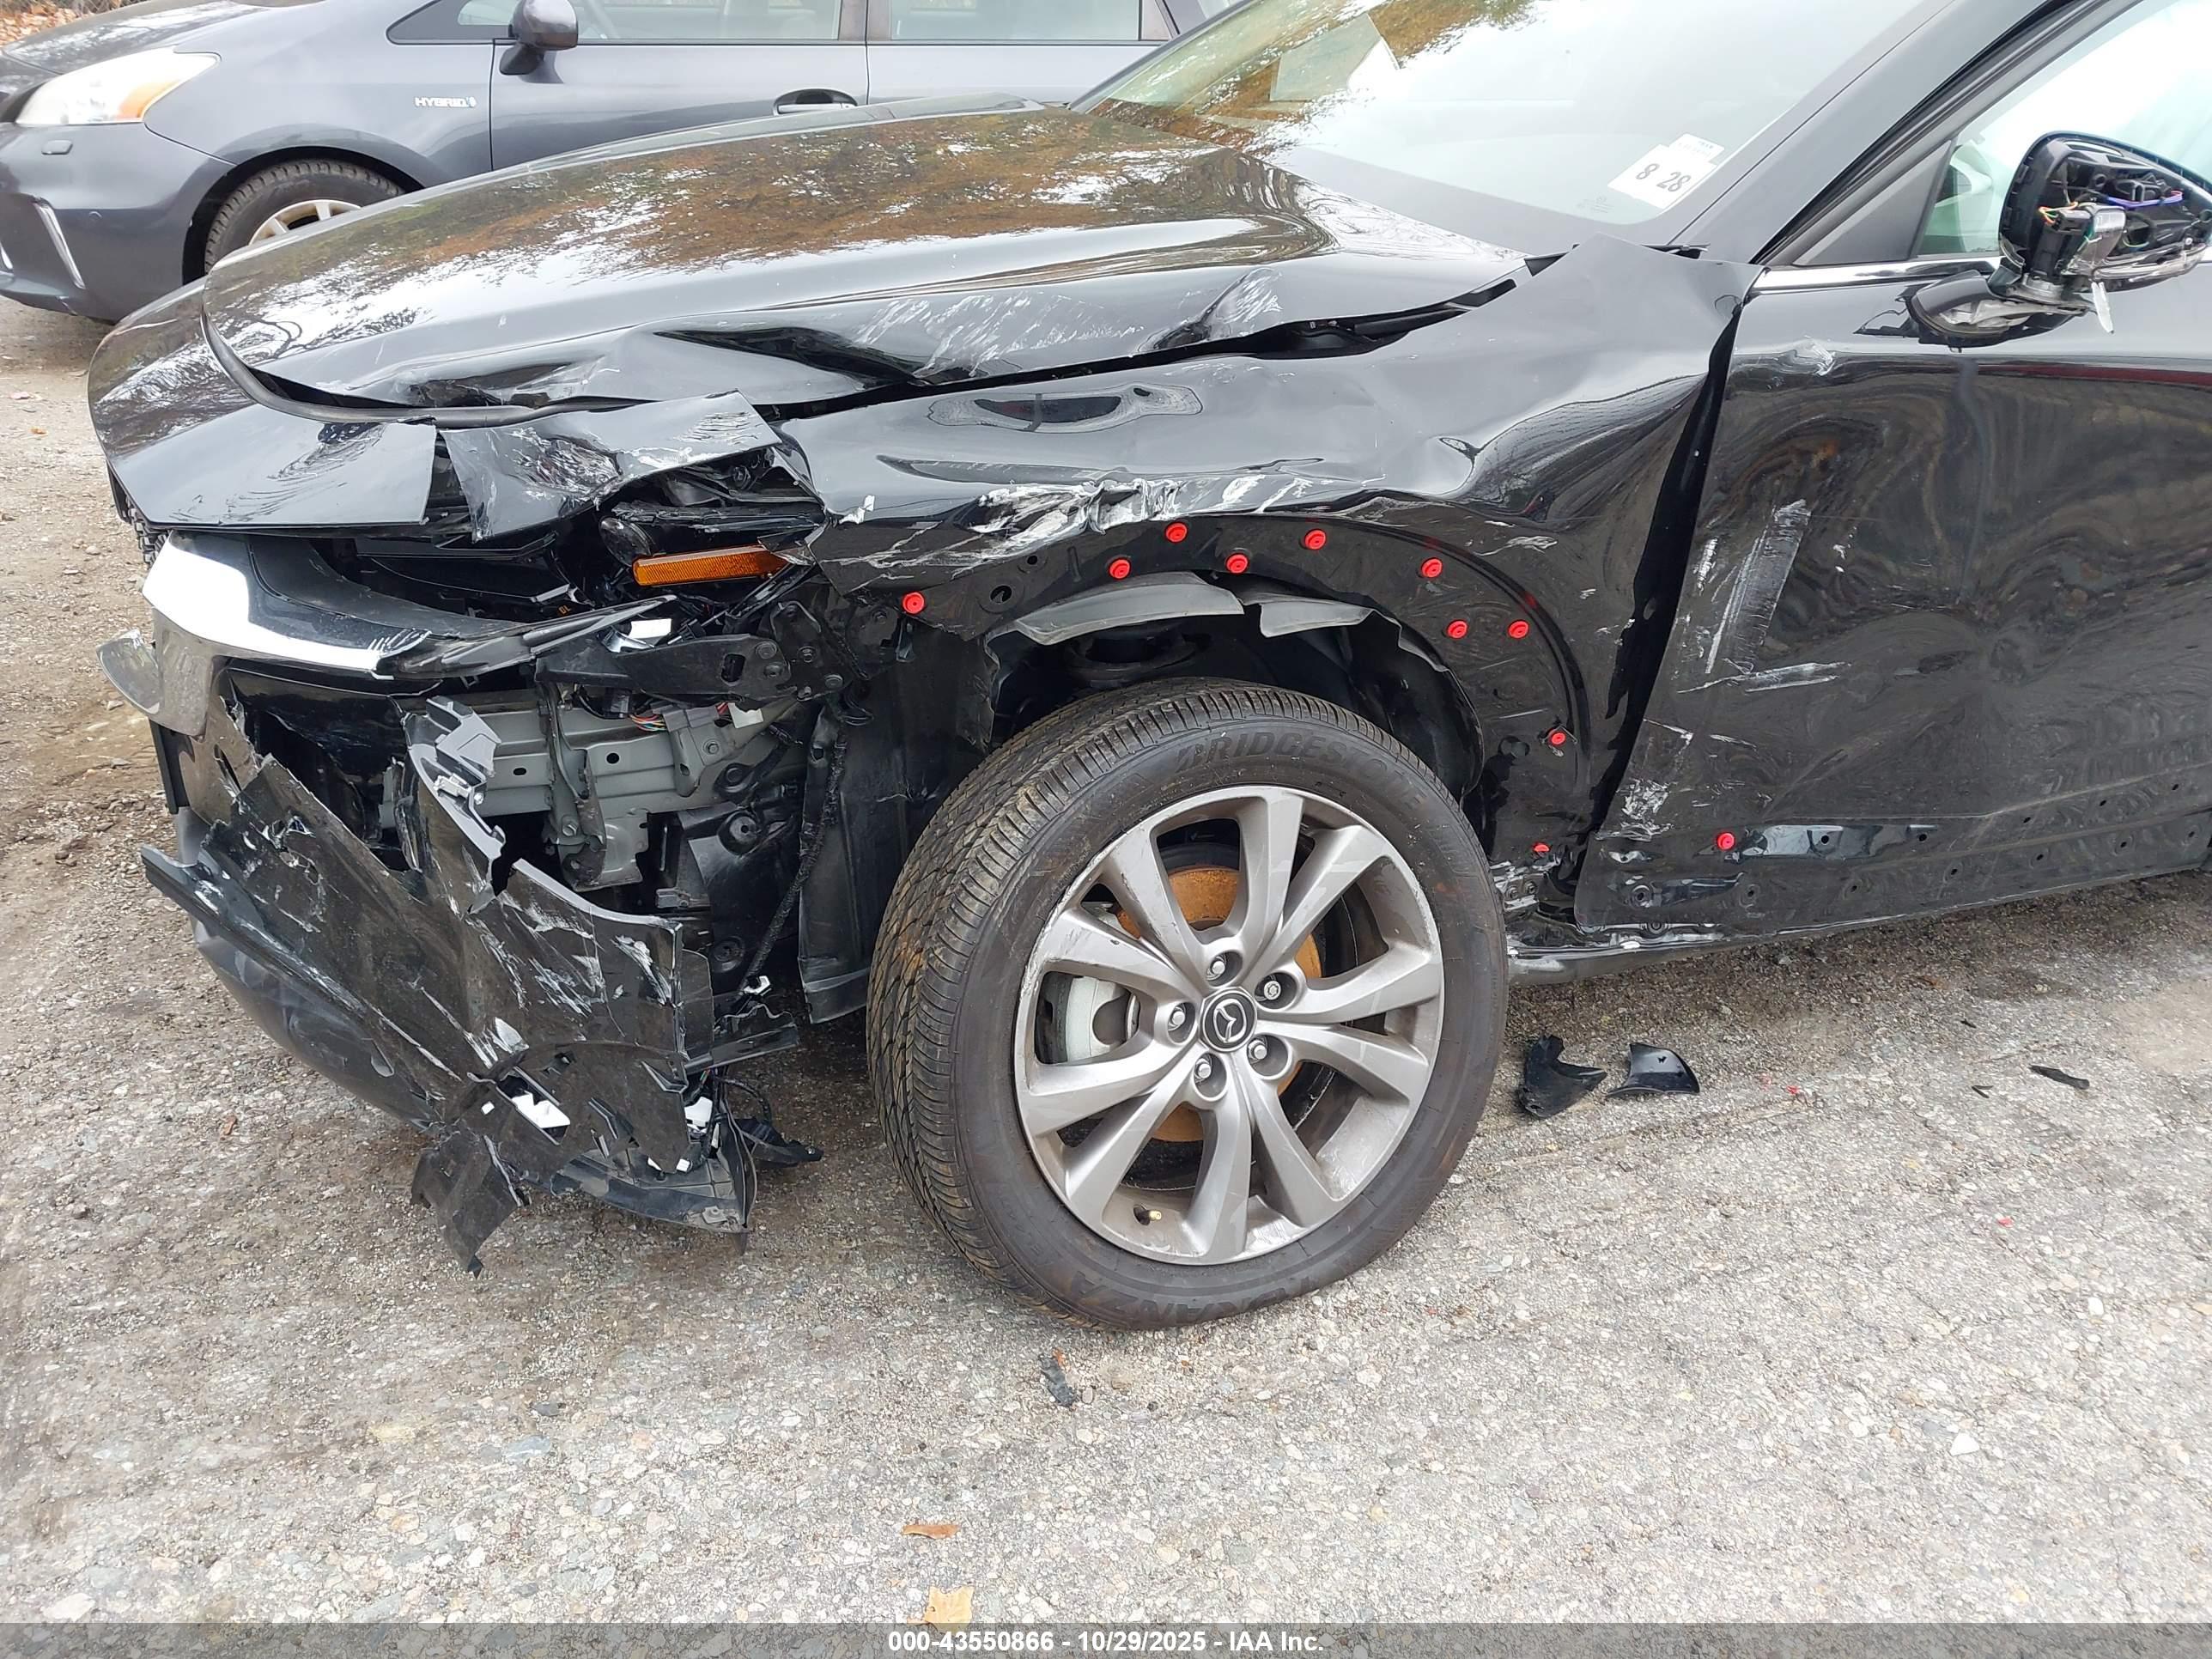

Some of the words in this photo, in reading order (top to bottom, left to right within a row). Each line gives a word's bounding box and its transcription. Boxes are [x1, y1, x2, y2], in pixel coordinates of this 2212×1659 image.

[415, 96, 469, 107] HYBRID
[1635, 162, 1661, 180] 8
[1656, 171, 1692, 192] 28
[1175, 732, 1428, 810] BRIDGESTONE
